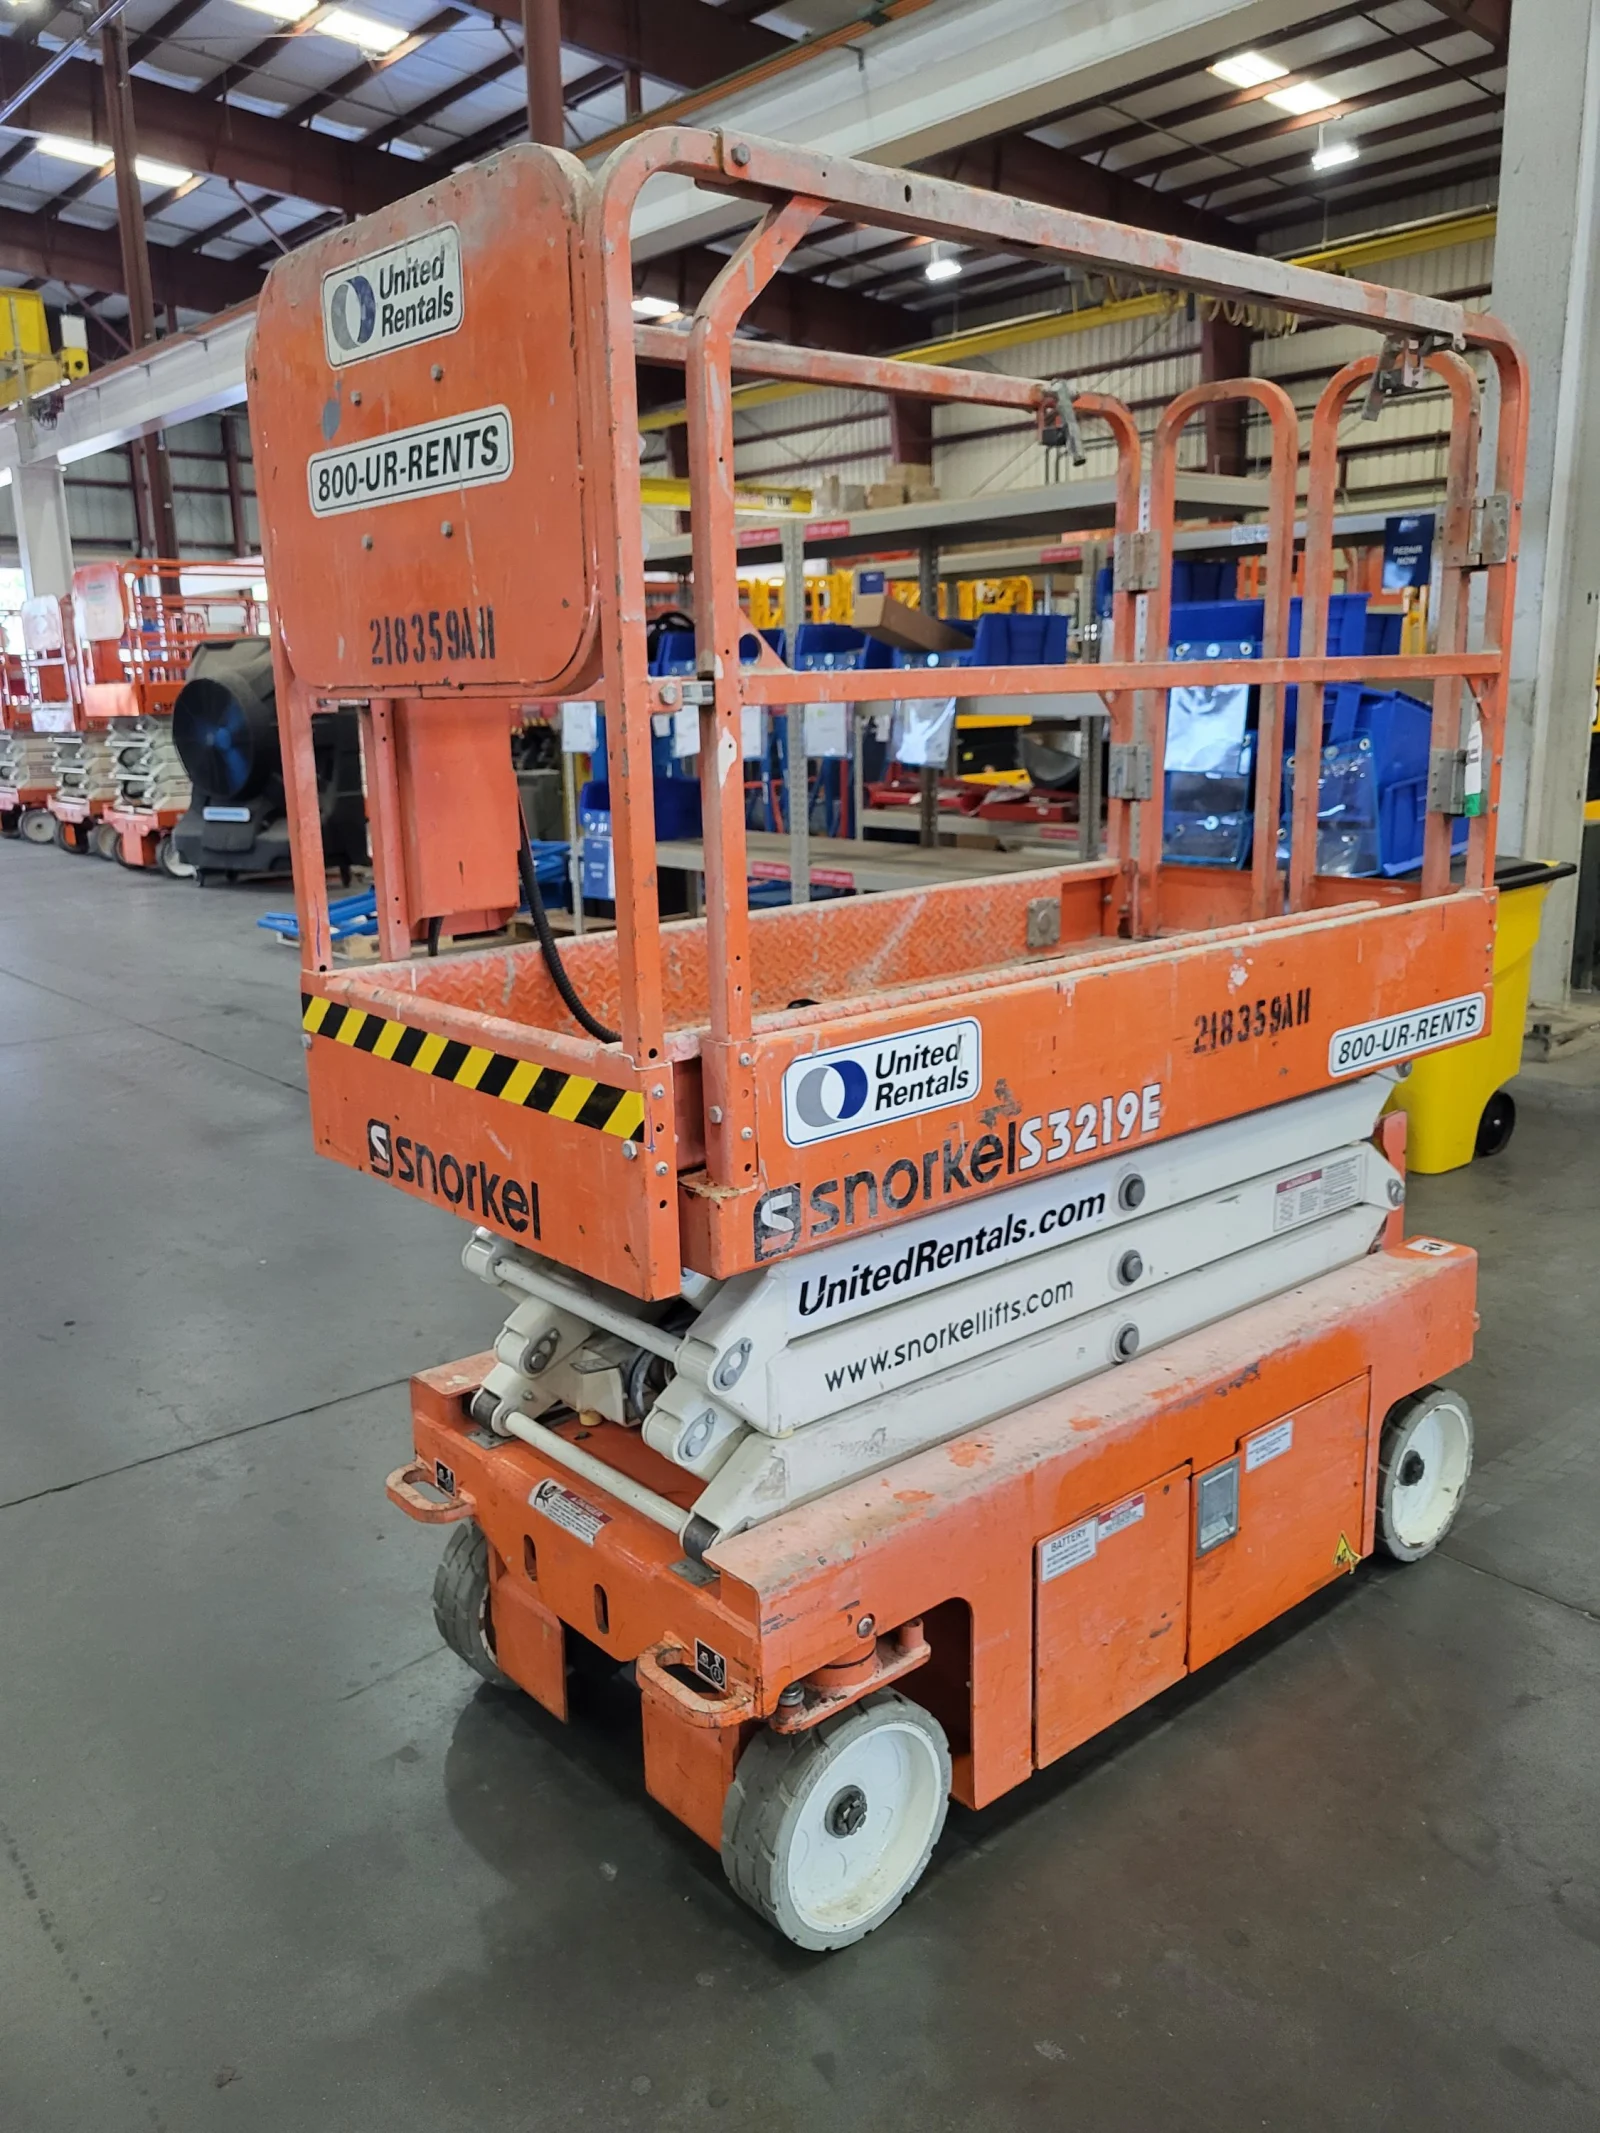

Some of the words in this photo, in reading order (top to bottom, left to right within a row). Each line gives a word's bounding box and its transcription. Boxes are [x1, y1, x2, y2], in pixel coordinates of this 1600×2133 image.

[379, 245, 445, 299] United
[381, 284, 454, 337] Rentals
[318, 424, 499, 502] 800-UR-RENTS
[875, 1034, 962, 1079] United
[1338, 1004, 1477, 1065] 800-UR-RENTS
[875, 1066, 969, 1111] Rentals
[395, 1135, 542, 1241] snorkel
[810, 1122, 1017, 1237] snorkel
[1018, 1082, 1161, 1171] S3219E
[798, 1191, 1106, 1316] UnitedRentals.com
[824, 1279, 1074, 1392] www.snorkellifts.com
[1050, 1527, 1087, 1553] BATTERY
